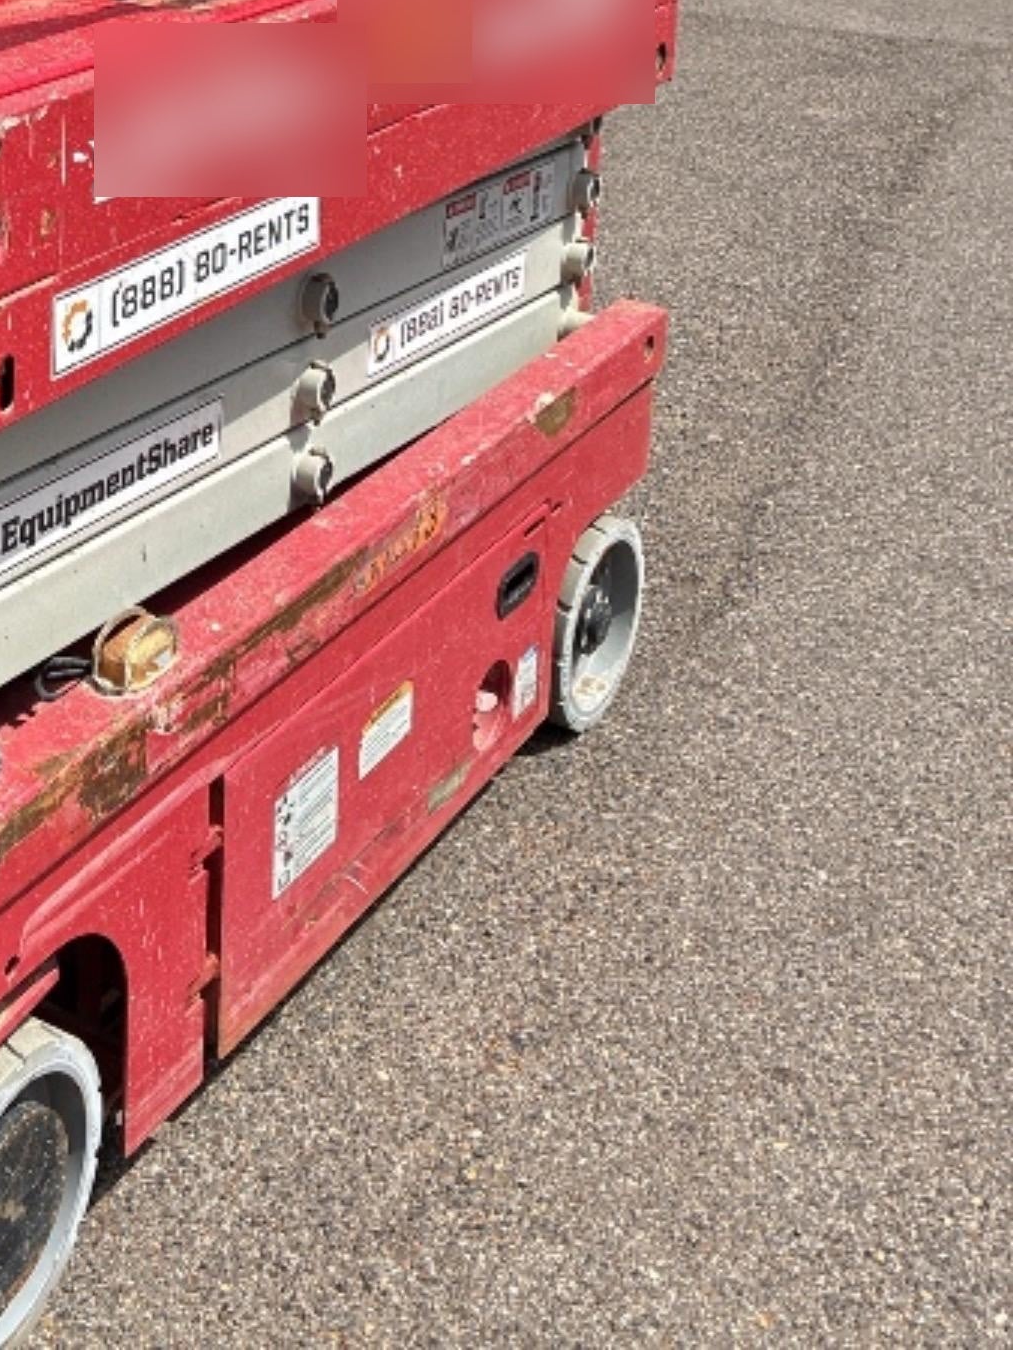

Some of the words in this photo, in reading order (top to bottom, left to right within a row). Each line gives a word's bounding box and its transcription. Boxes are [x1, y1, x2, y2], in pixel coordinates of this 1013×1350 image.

[112, 258, 184, 328] (888)
[195, 203, 310, 282] 80-RENTS
[0, 422, 214, 555] EquipmentShare
